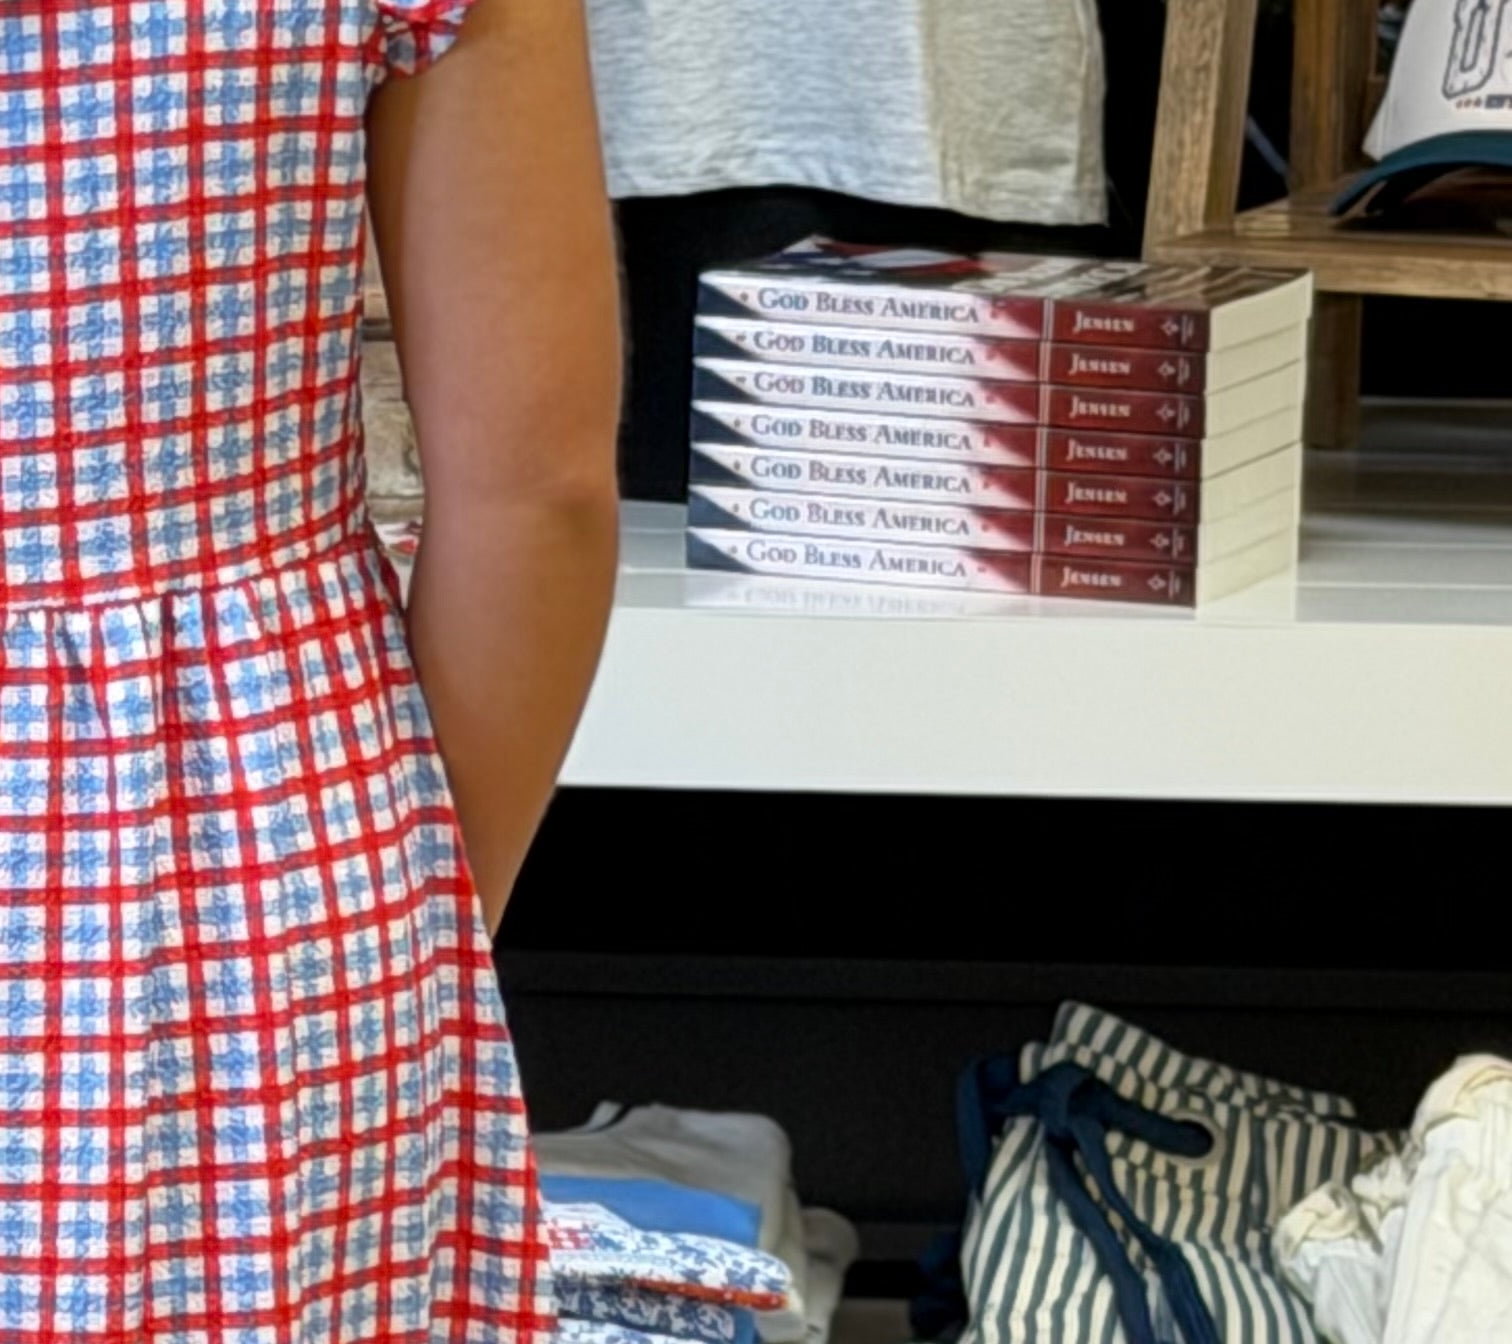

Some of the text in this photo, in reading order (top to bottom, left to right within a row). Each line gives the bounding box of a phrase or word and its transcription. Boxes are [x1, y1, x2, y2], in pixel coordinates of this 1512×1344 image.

[757, 287, 809, 311] GOD
[816, 292, 875, 315] BLESS
[880, 297, 980, 324] AMERICA
[753, 330, 805, 352] GOD
[811, 334, 871, 358] BLESS
[875, 339, 976, 365] AMERICA
[753, 371, 805, 394] GOD
[811, 376, 871, 400] BLESS
[875, 380, 975, 407] AMERICA
[750, 413, 802, 437] GOD
[808, 418, 868, 442] BLESS
[873, 424, 973, 451] AMERICA
[750, 455, 802, 480] GOD
[808, 459, 867, 485] BLESS
[872, 465, 972, 494] AMERICA
[749, 497, 800, 523] GOD
[807, 502, 866, 527] BLESS
[871, 507, 970, 536] AMERICA
[746, 539, 798, 564] GOD
[804, 544, 862, 569] BLESS
[868, 549, 967, 577] AMERICA
